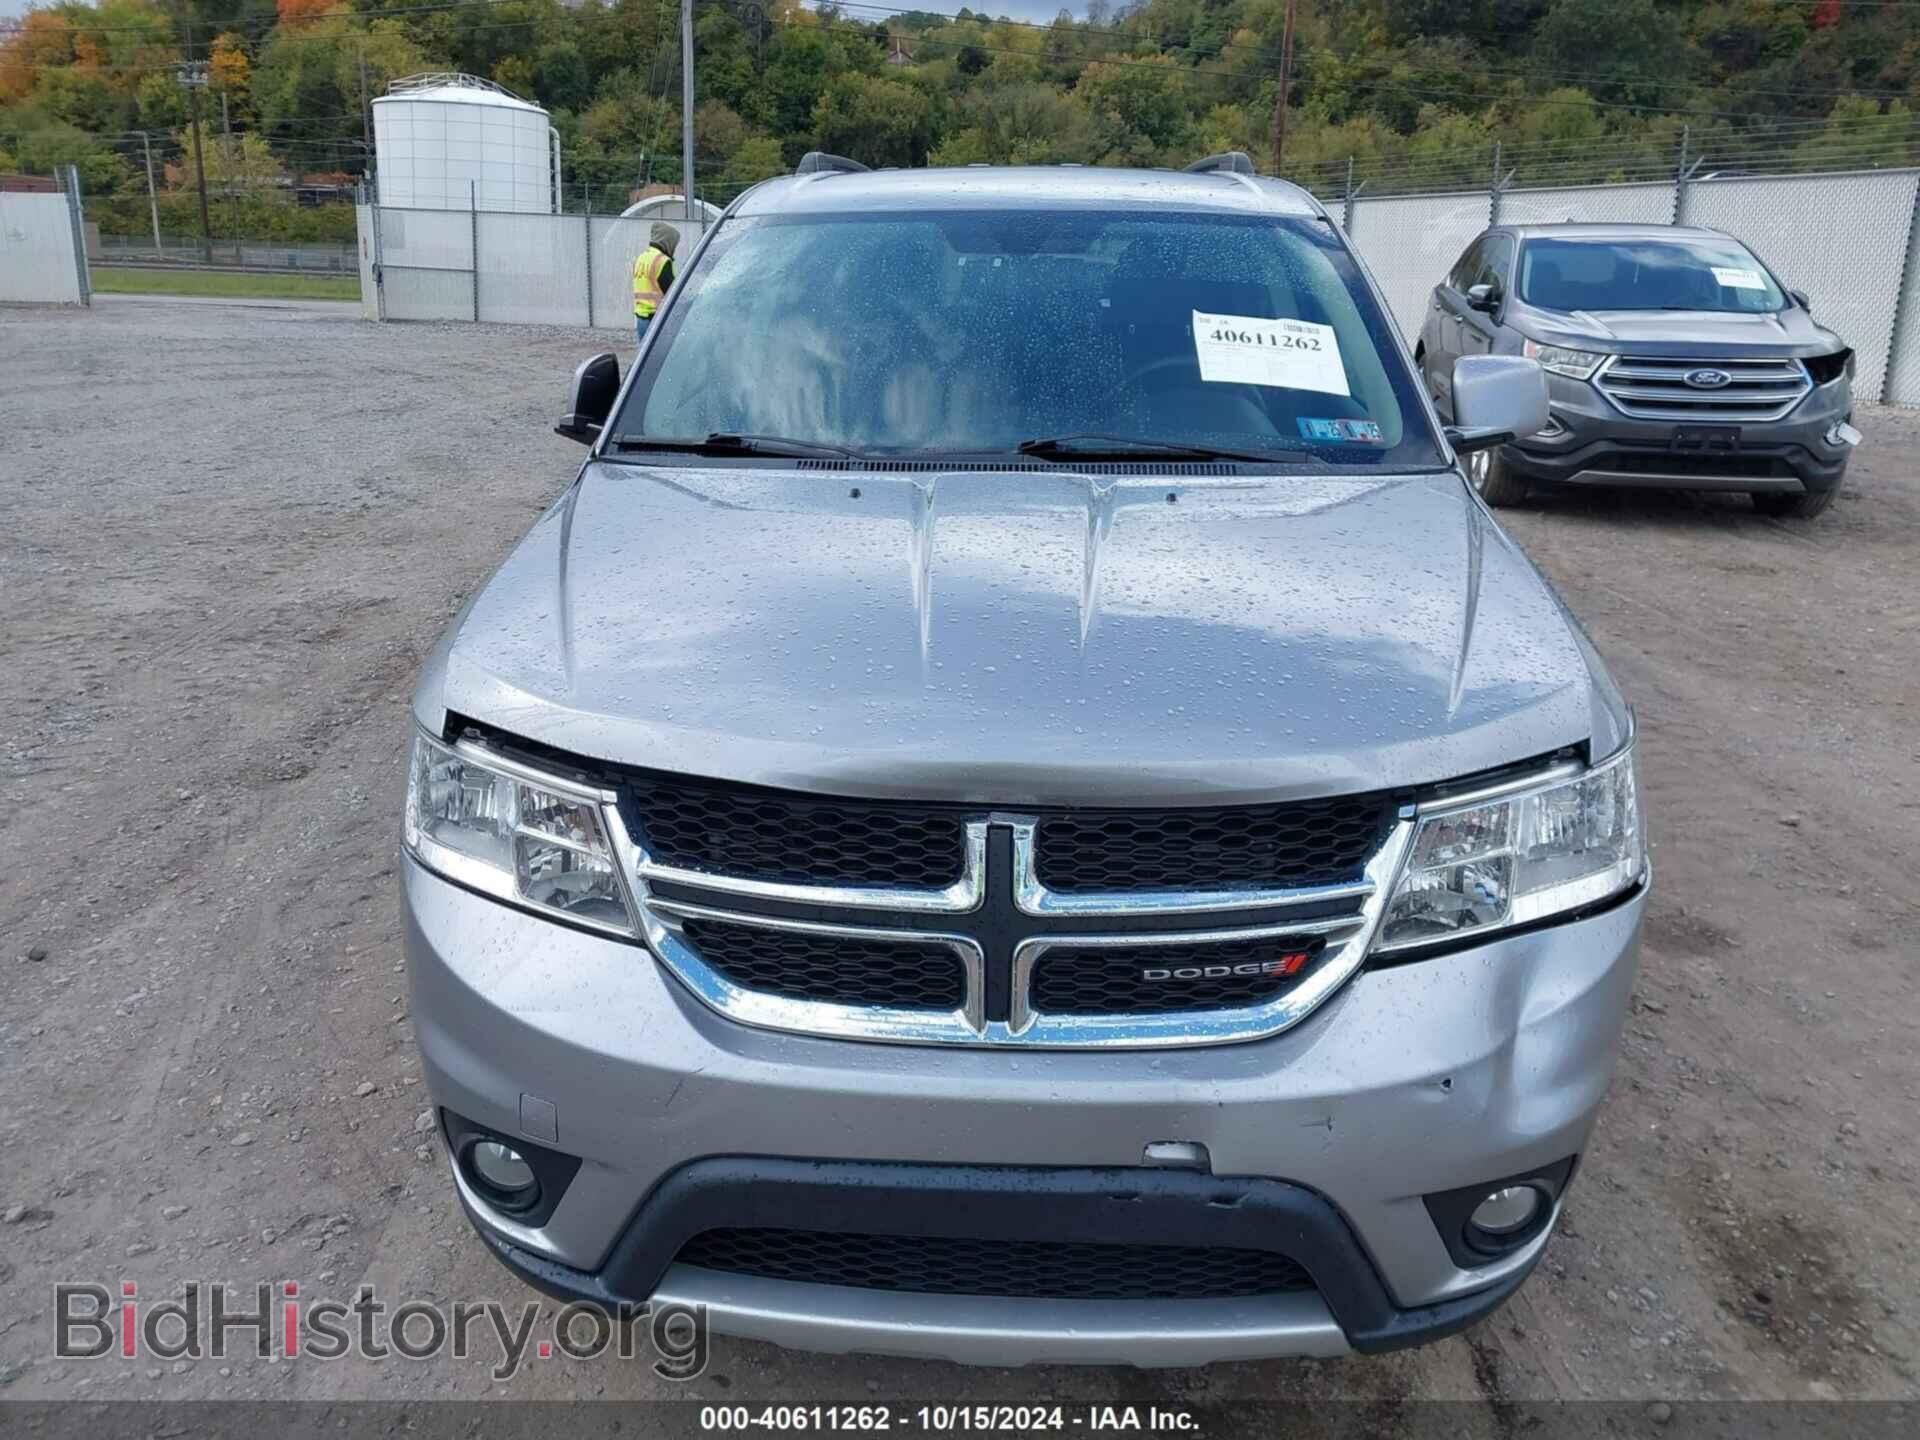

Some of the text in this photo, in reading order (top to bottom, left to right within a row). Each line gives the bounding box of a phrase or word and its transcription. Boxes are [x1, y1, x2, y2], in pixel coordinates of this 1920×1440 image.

[1210, 329, 1322, 351] 40611262
[1695, 372, 1722, 383] Ford
[1144, 960, 1286, 980] DODGE
